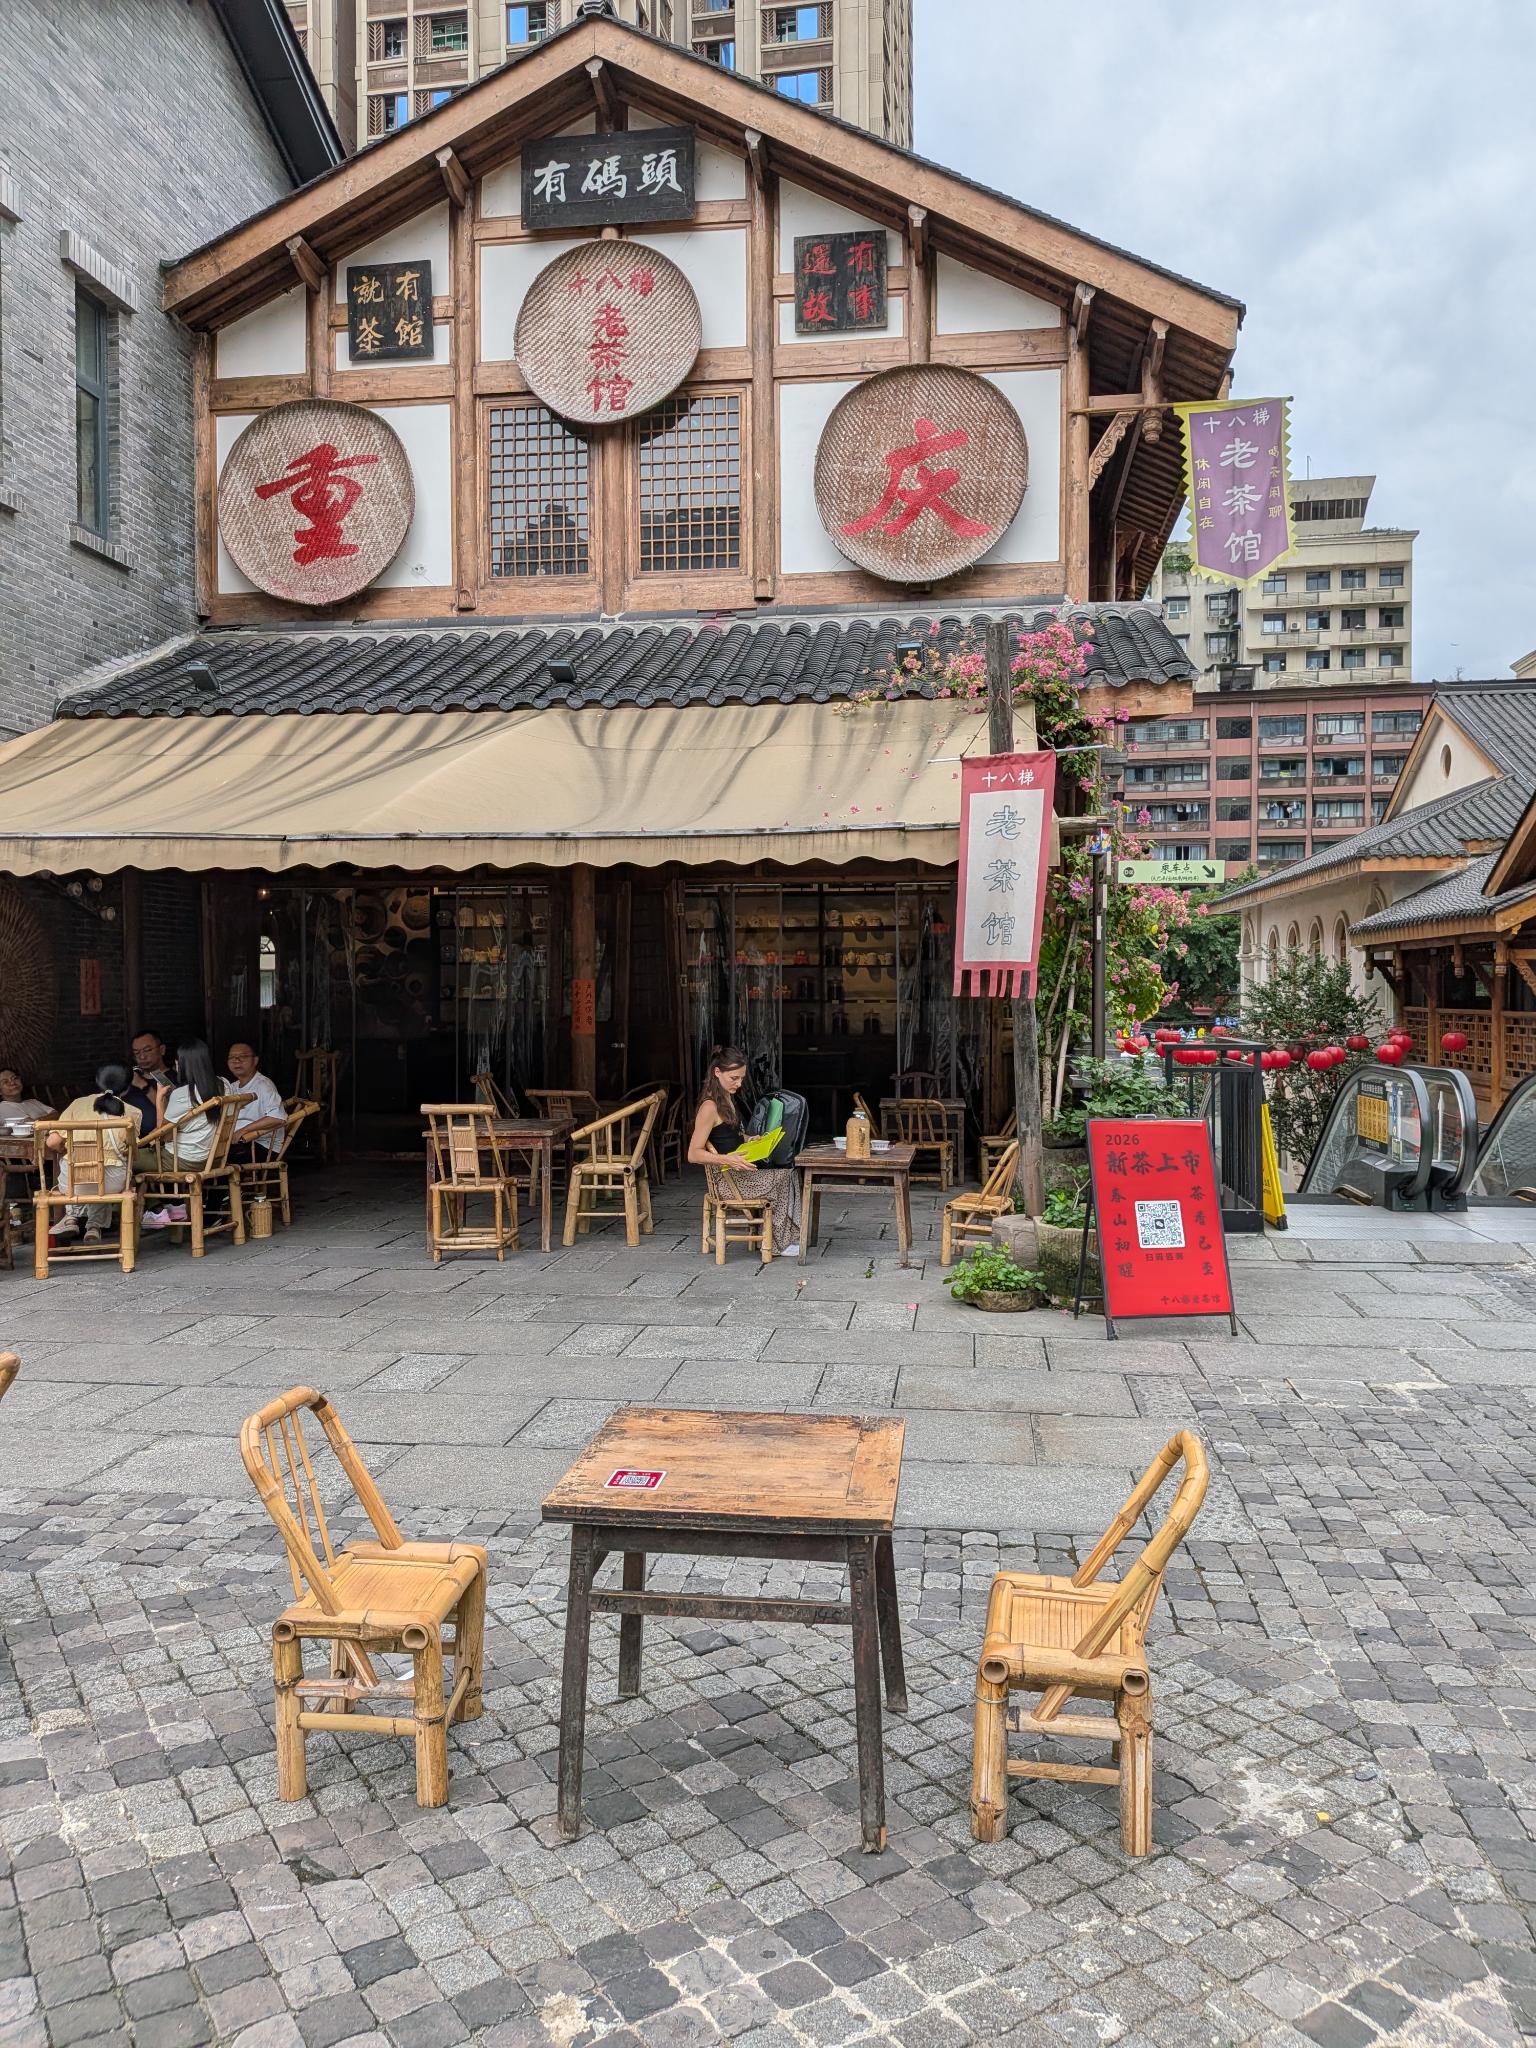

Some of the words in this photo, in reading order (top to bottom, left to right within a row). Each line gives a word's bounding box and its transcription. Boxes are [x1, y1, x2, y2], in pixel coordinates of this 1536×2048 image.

[533, 149, 685, 203] 有碼頭
[568, 267, 655, 297] 十八梯
[1203, 407, 1270, 434] 十八梯
[841, 416, 992, 539] 庆
[1194, 458, 1215, 530] 休闲自在
[256, 442, 379, 567] 重
[1219, 437, 1263, 564] 老茶馆
[981, 769, 1035, 788] 十八梯
[980, 805, 1026, 946] 老茶馆
[1160, 862, 1193, 875] 乘车点
[1105, 1134, 1140, 1146] 2026
[1105, 1151, 1201, 1176] 新茶上市
